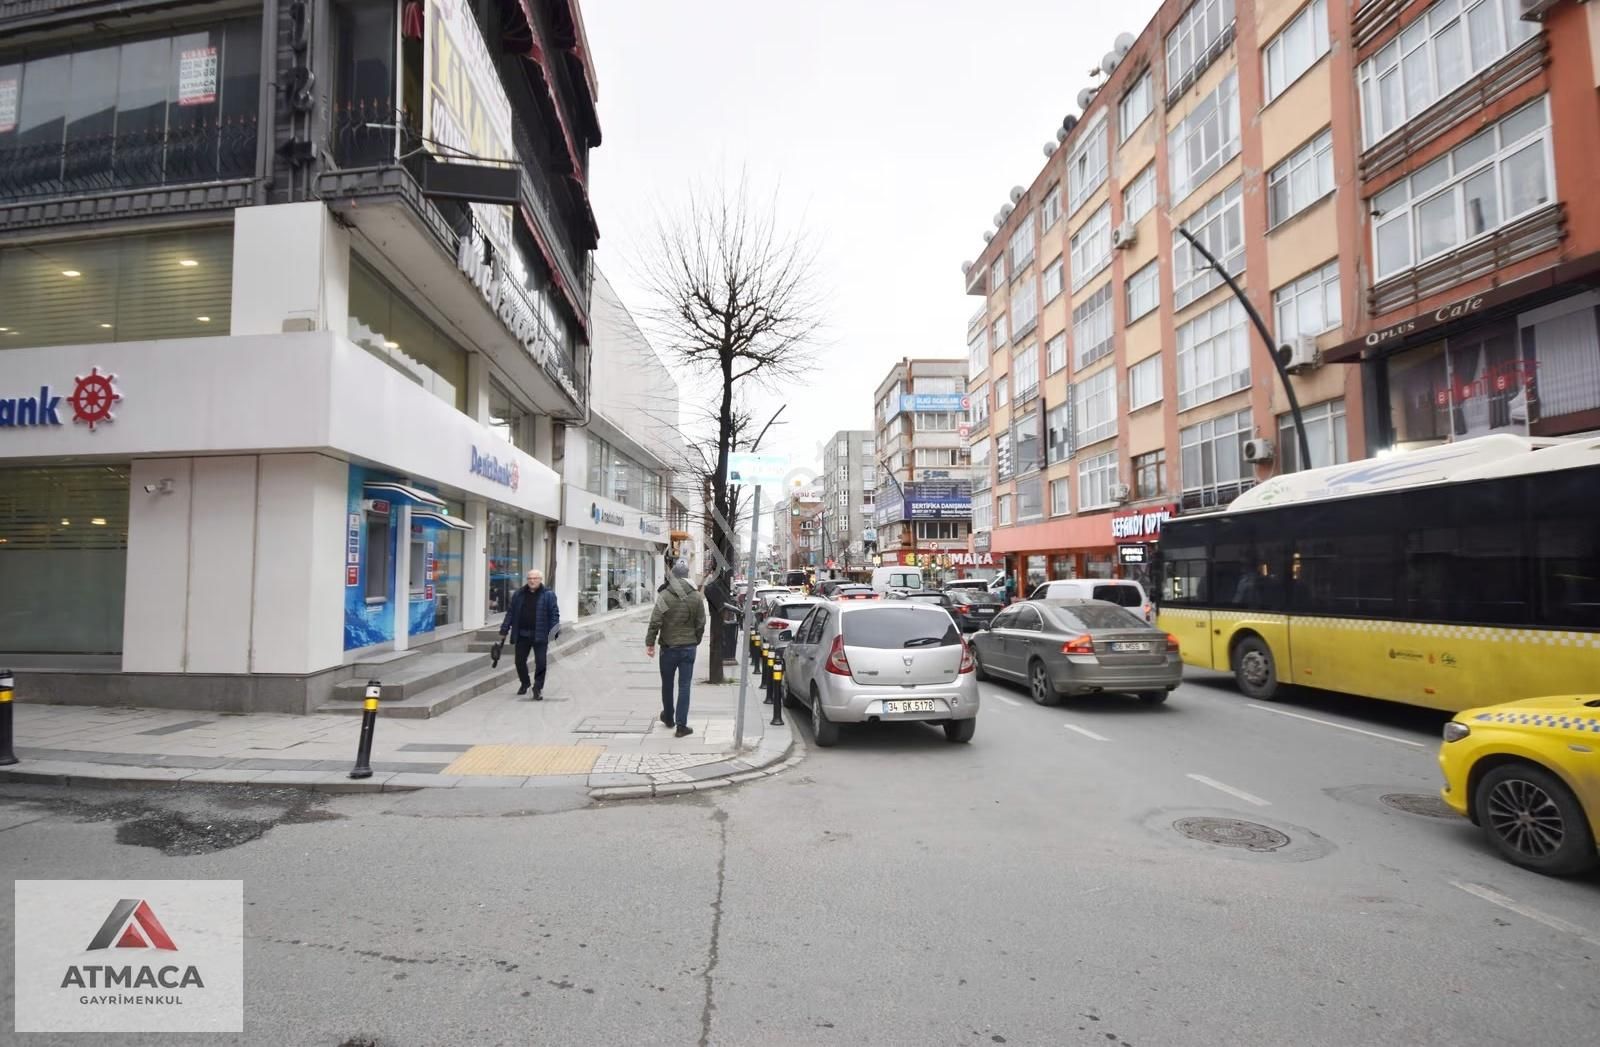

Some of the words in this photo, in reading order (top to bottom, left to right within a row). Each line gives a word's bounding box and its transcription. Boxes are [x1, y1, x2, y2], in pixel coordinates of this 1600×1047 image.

[1435, 297, 1483, 322] Cafe
[470, 444, 511, 486] DenizBank
[888, 702, 898, 711] 34
[902, 701, 912, 711] GK
[914, 701, 934, 710] 5178
